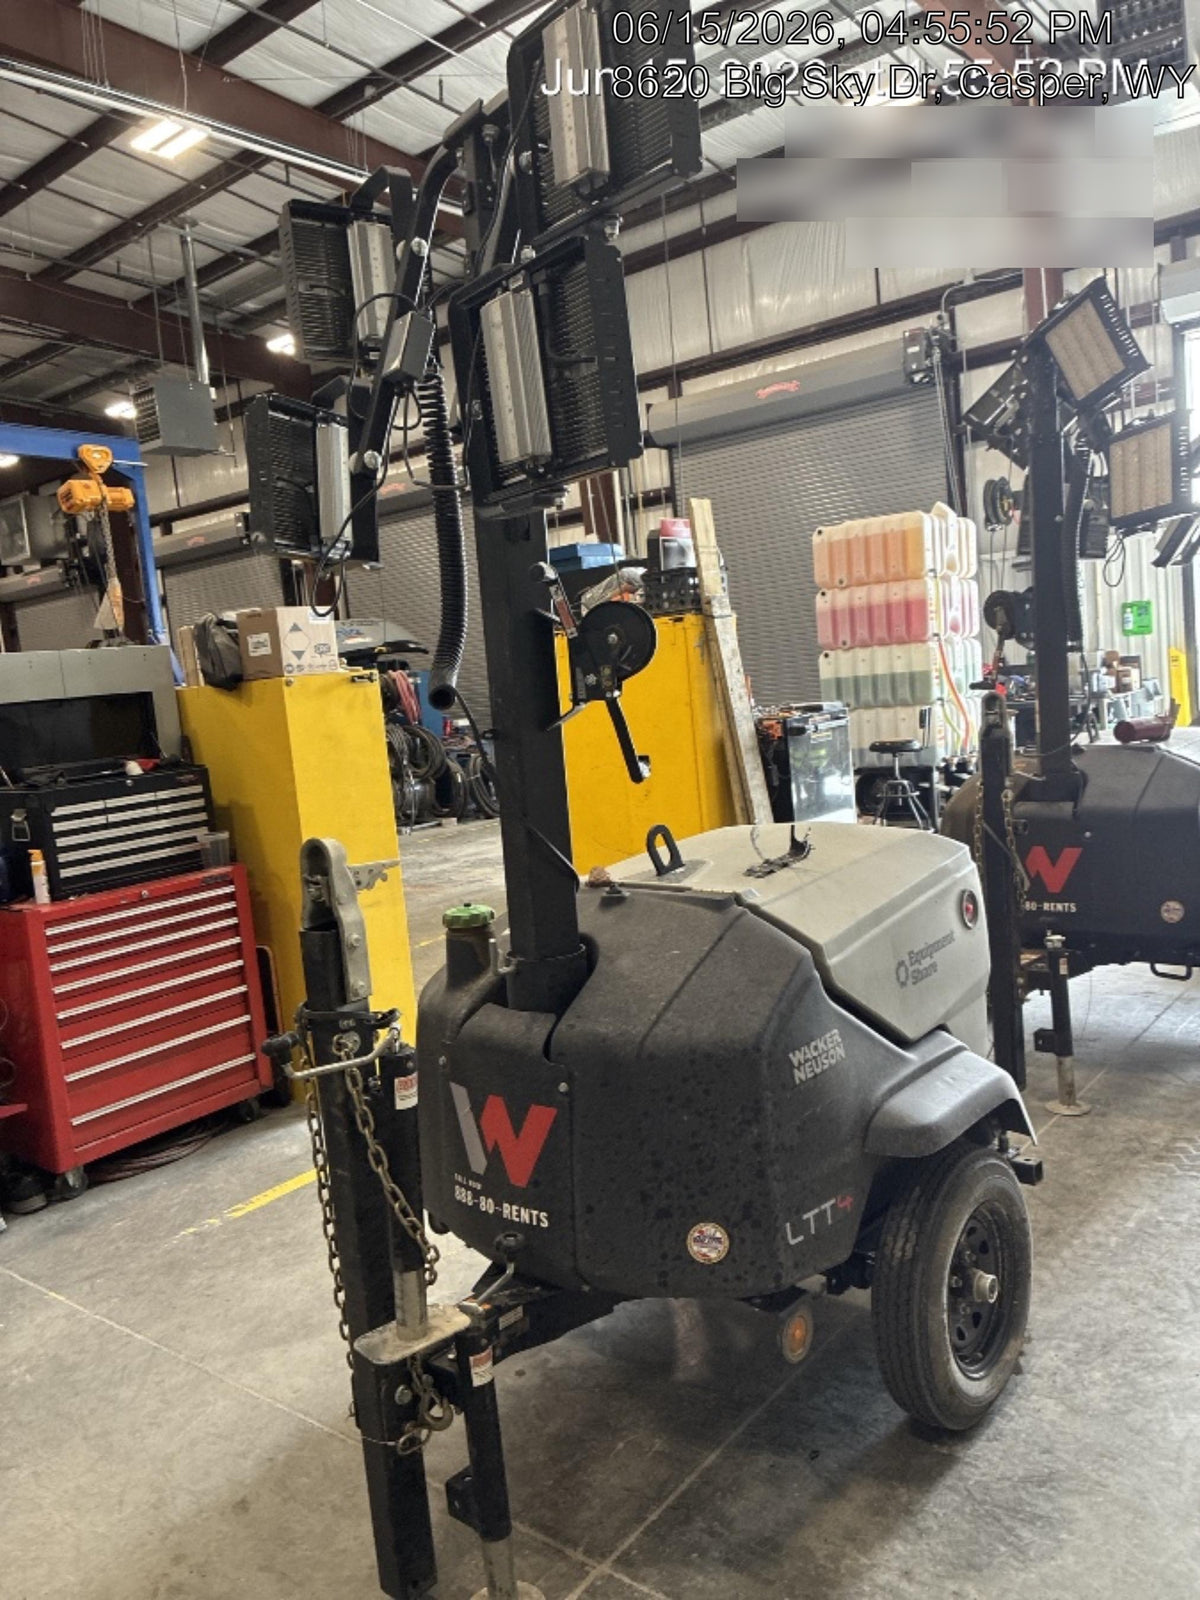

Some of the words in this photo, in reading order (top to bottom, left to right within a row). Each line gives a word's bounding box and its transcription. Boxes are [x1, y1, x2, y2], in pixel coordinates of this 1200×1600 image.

[788, 1029, 842, 1068] WACKER
[793, 1043, 846, 1085] NEUSON
[455, 1185, 549, 1228] 888-80-RENTS
